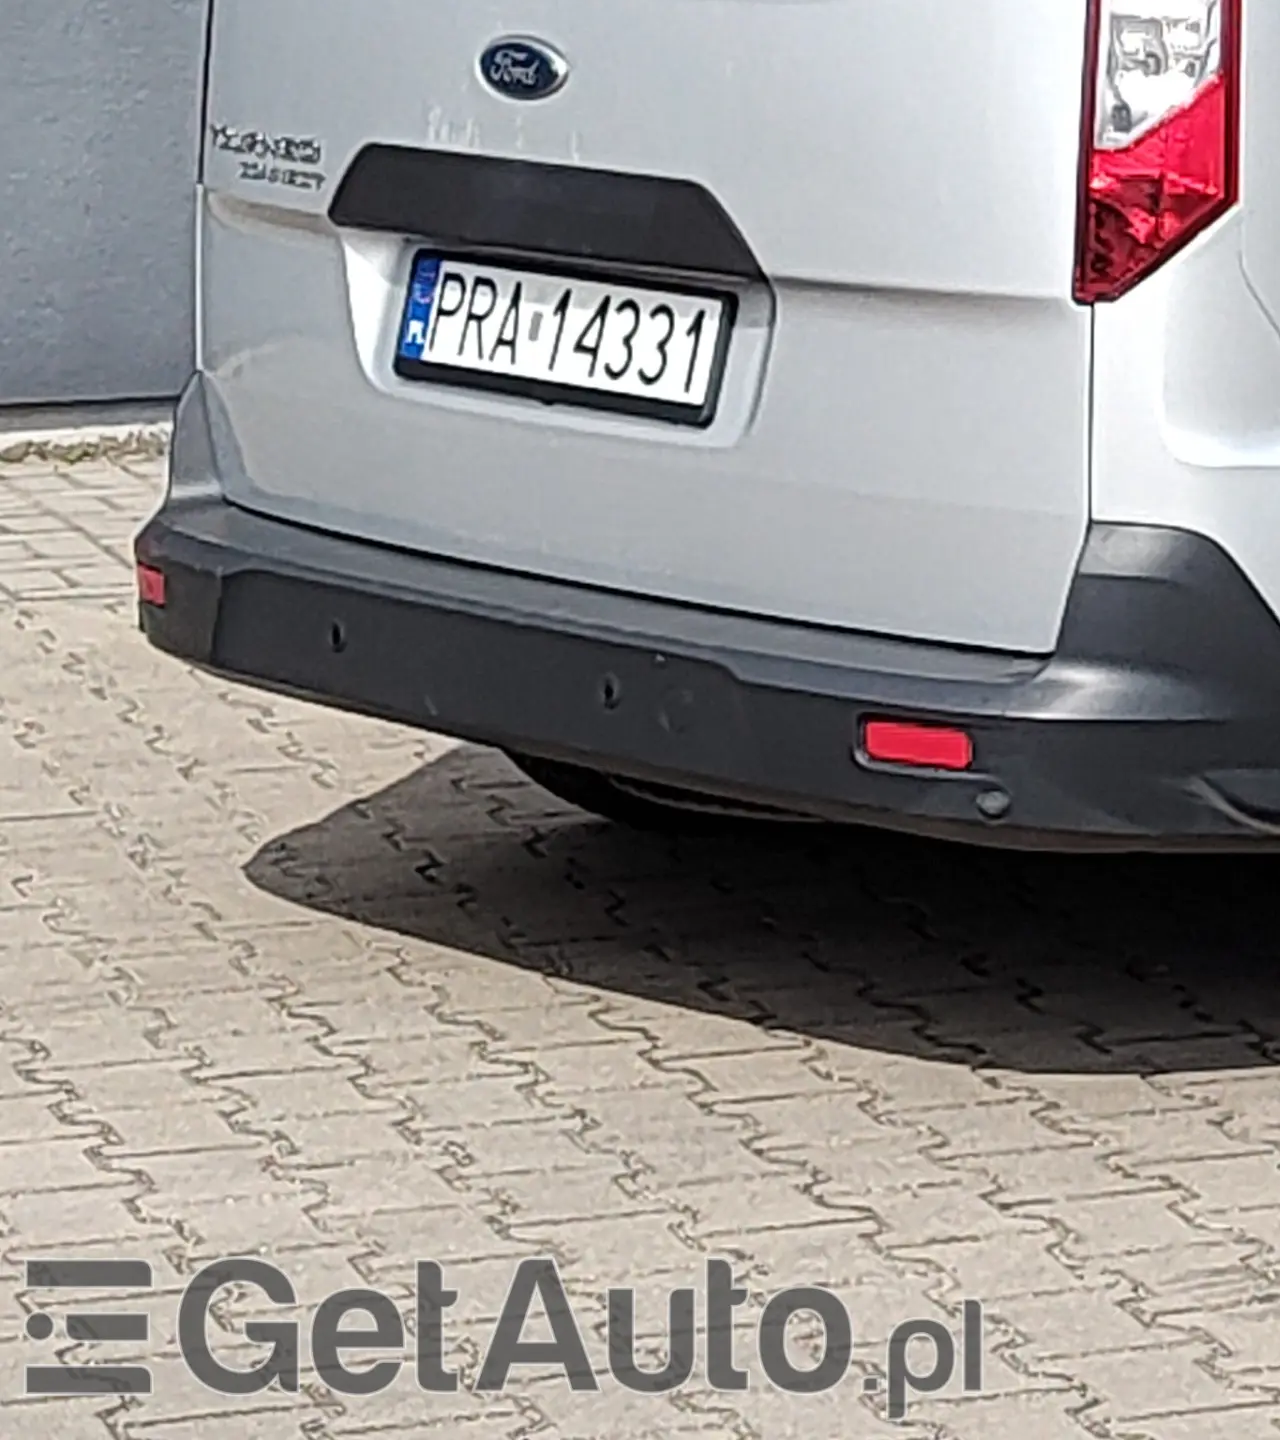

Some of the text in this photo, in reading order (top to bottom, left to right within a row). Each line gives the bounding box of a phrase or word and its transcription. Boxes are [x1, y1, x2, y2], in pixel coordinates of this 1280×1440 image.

[490, 49, 539, 85] Ford
[429, 272, 705, 393] PRA 14331
